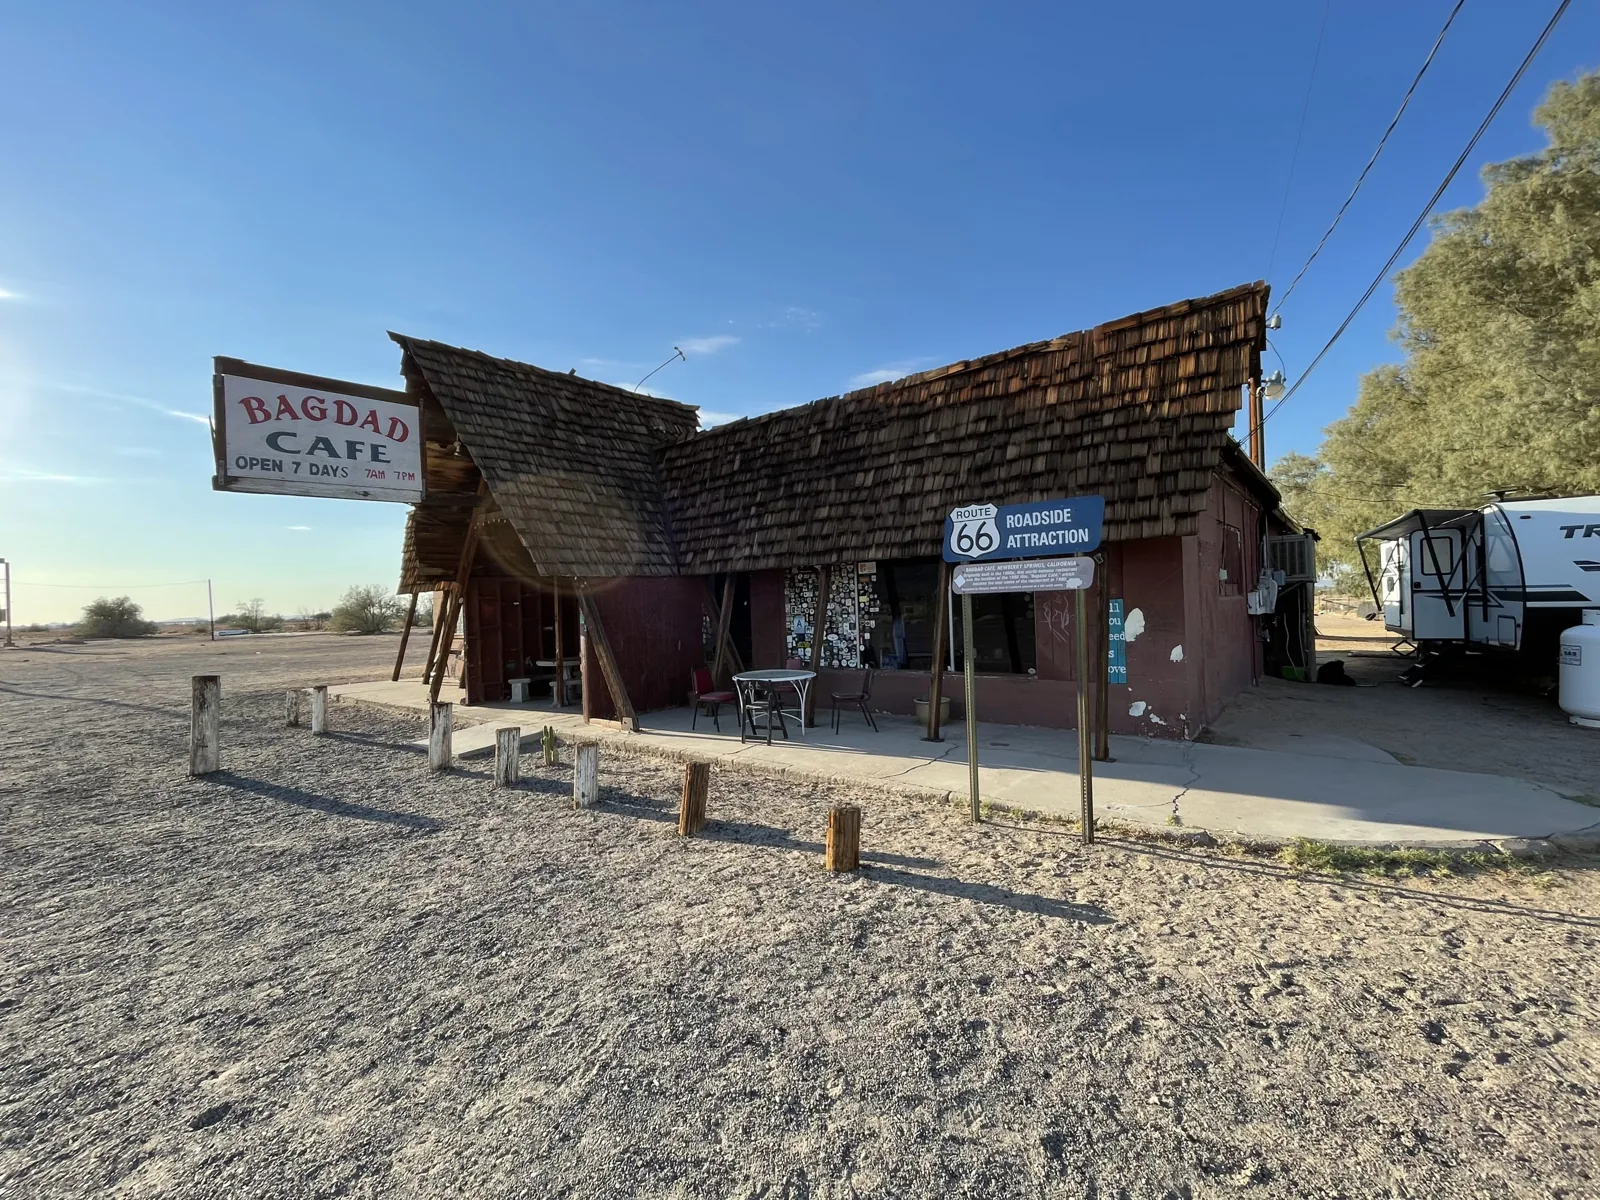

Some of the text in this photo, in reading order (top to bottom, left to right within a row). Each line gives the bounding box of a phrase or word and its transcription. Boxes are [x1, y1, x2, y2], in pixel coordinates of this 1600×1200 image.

[238, 394, 409, 443] BAGDAD
[265, 431, 391, 464] CAFE
[235, 455, 416, 481] OPEN 7 DAYS 7AM 7PM
[956, 507, 991, 520] ROUTE
[1006, 508, 1072, 529] ROADSIDE
[957, 521, 993, 552] 66
[1007, 528, 1090, 549] ATTRACTION
[1109, 603, 1120, 613] ll
[1109, 617, 1121, 625] ou
[1109, 631, 1126, 641] eed
[1108, 665, 1127, 674] ove
